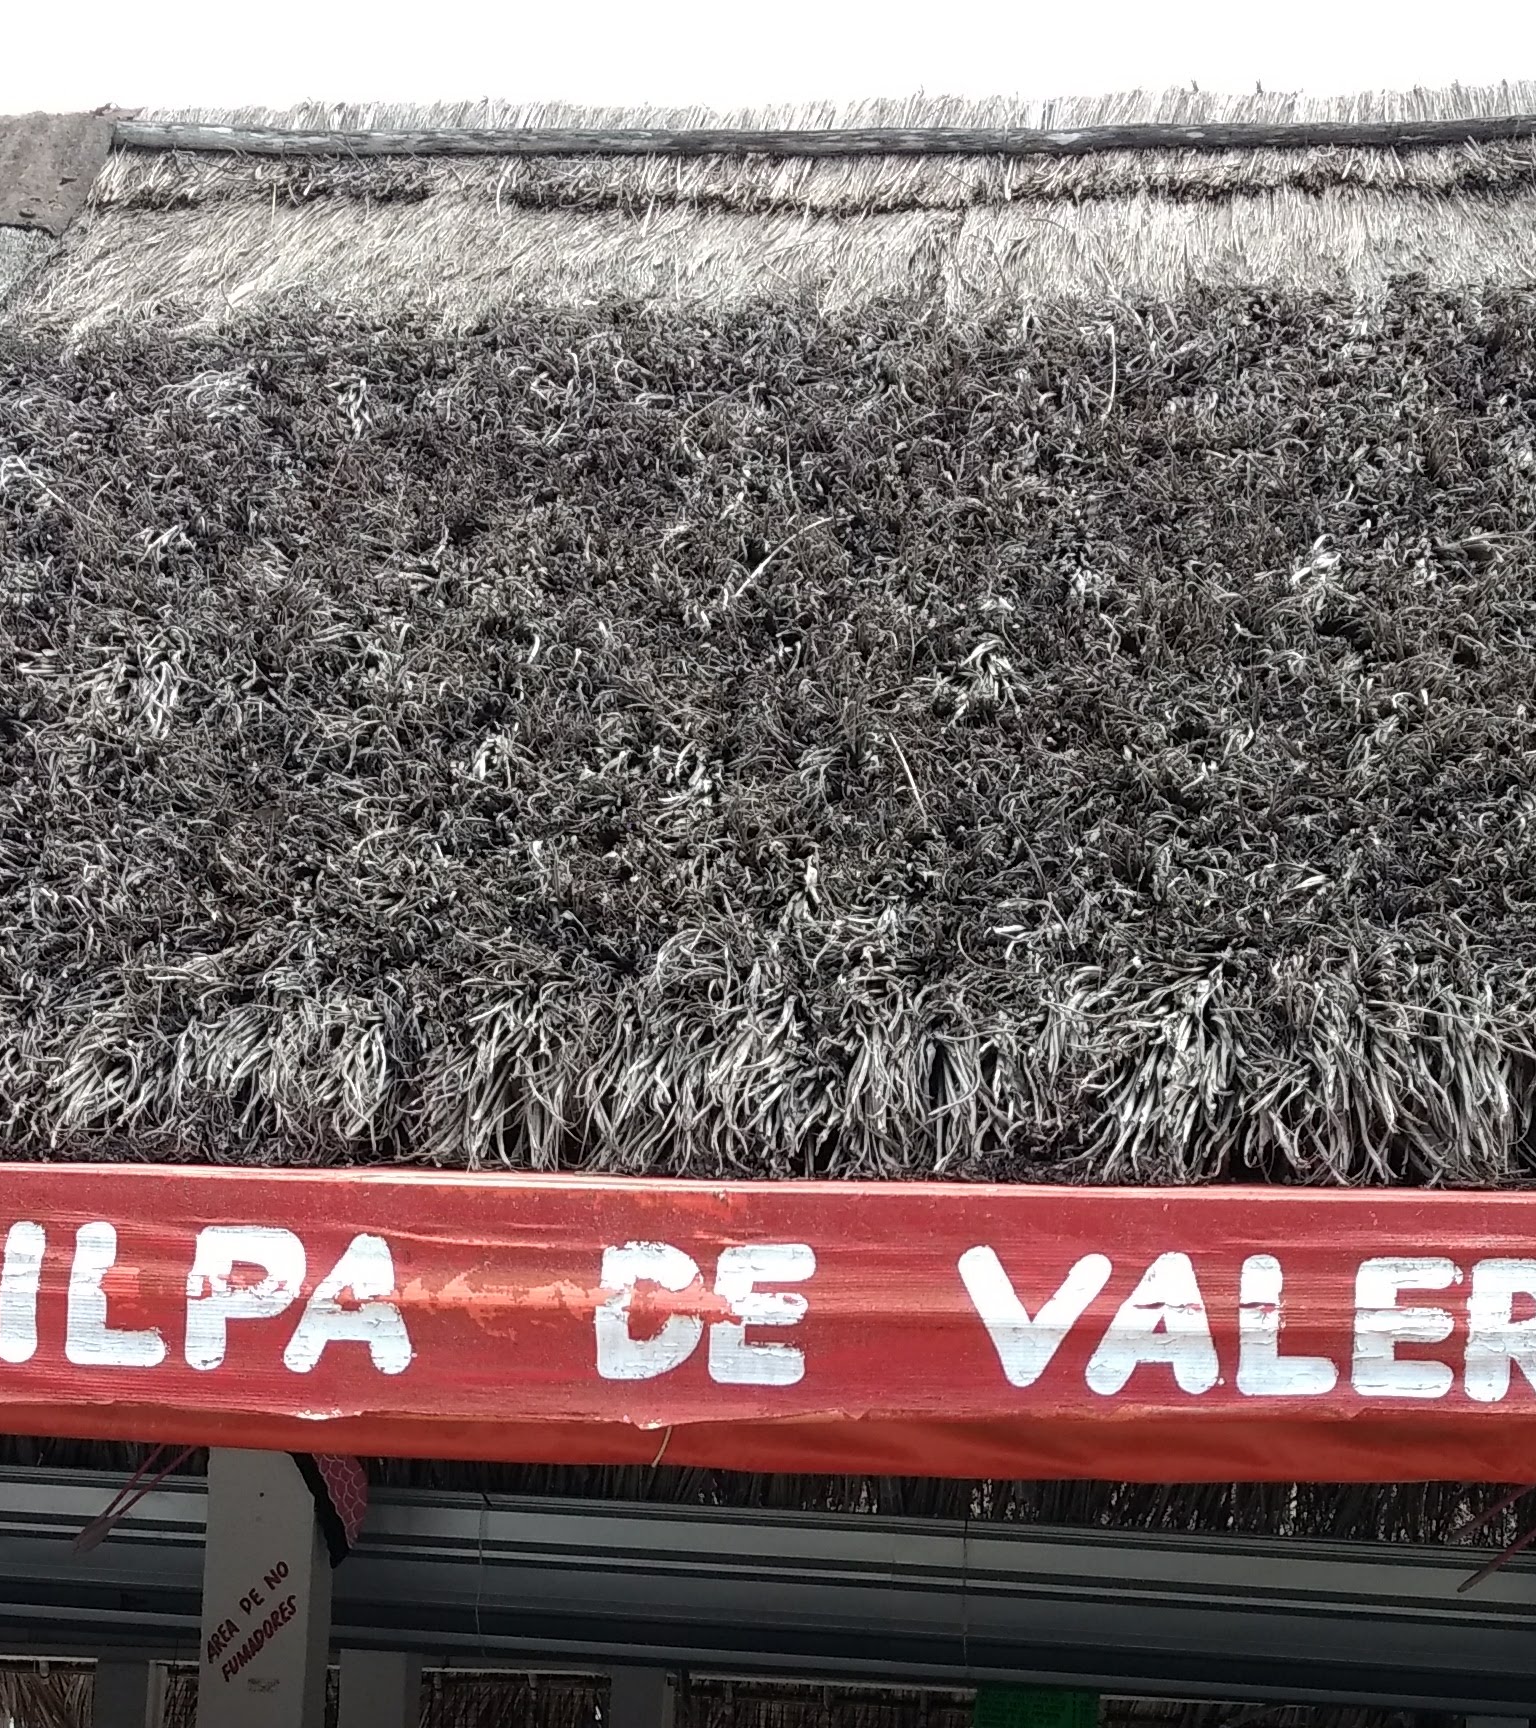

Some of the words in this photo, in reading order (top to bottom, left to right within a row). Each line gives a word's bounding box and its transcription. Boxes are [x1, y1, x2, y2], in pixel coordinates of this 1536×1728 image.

[596, 1241, 817, 1387] DE
[207, 1618, 240, 1664] AREA
[239, 1588, 265, 1615] DE
[264, 1561, 289, 1591] NO
[222, 1594, 296, 1683] FUMADORES
